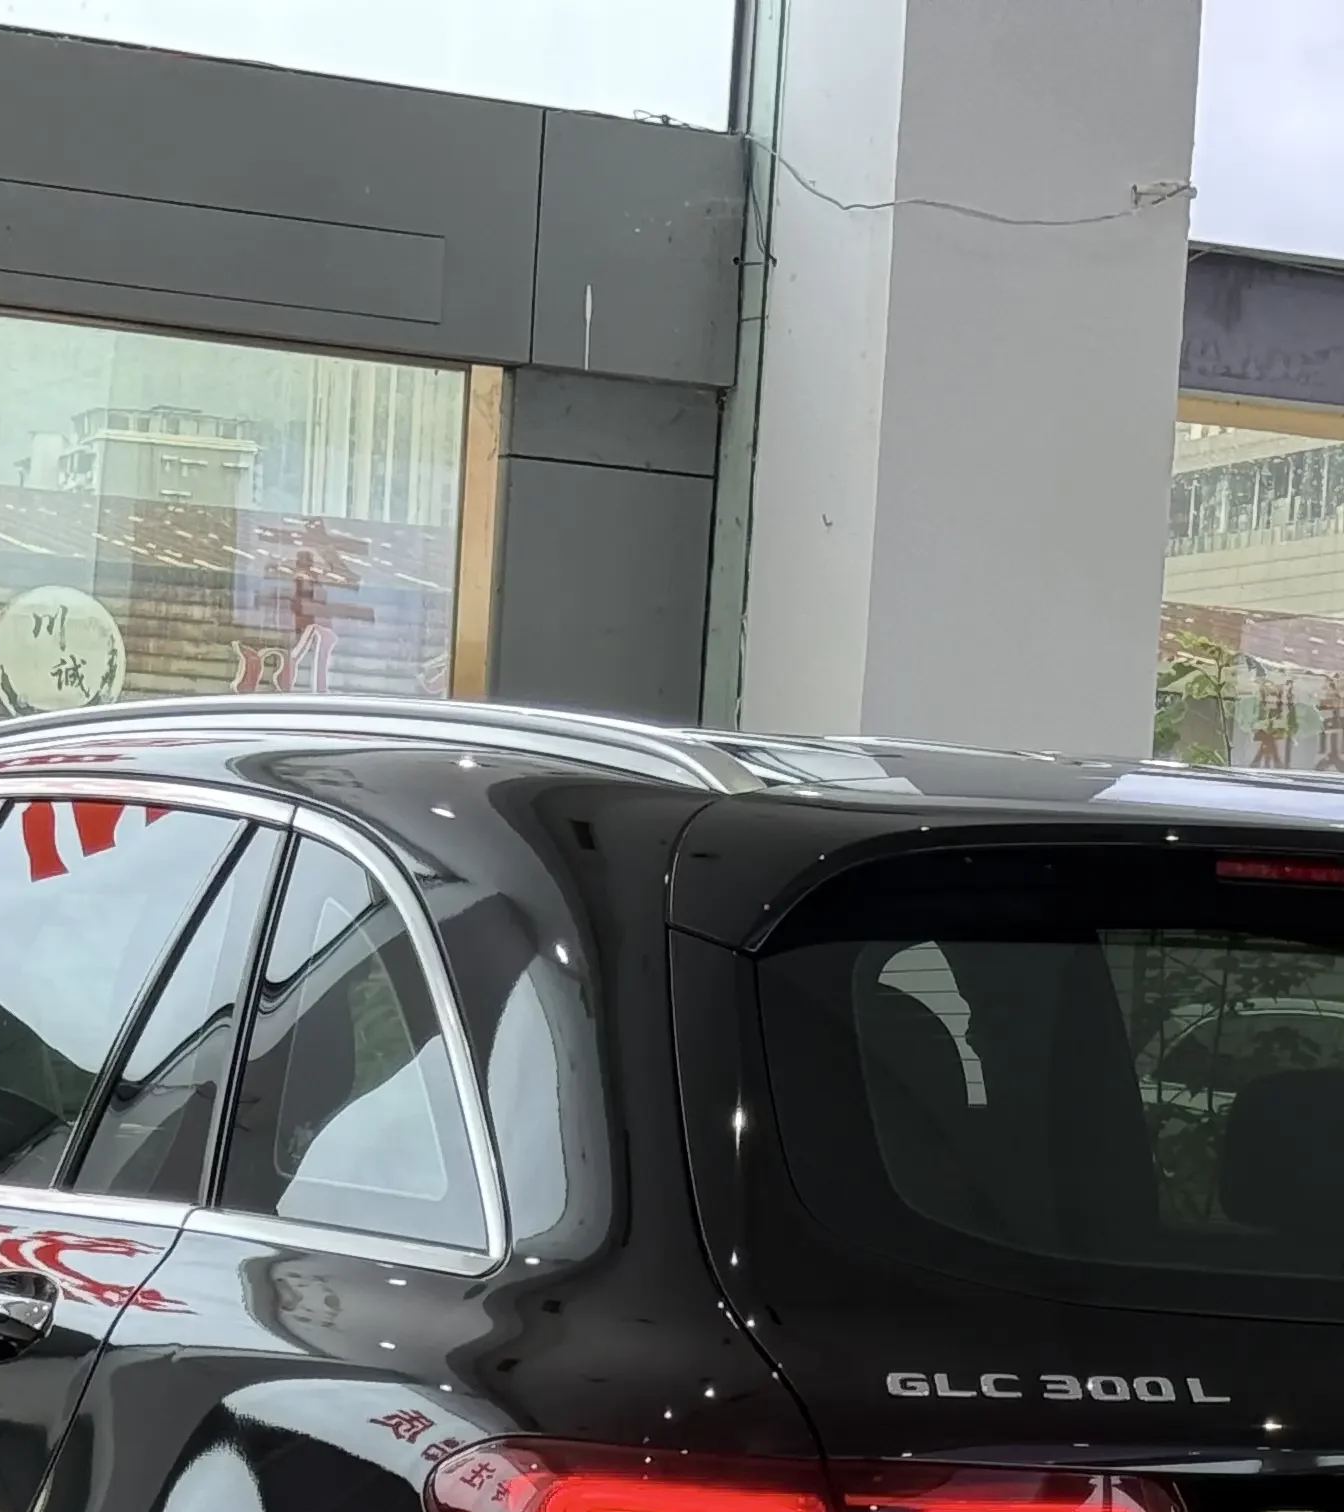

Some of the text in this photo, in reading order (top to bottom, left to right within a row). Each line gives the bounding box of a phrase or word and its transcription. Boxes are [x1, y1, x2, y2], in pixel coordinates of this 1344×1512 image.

[886, 1372, 1231, 1402] GLC 300 L
